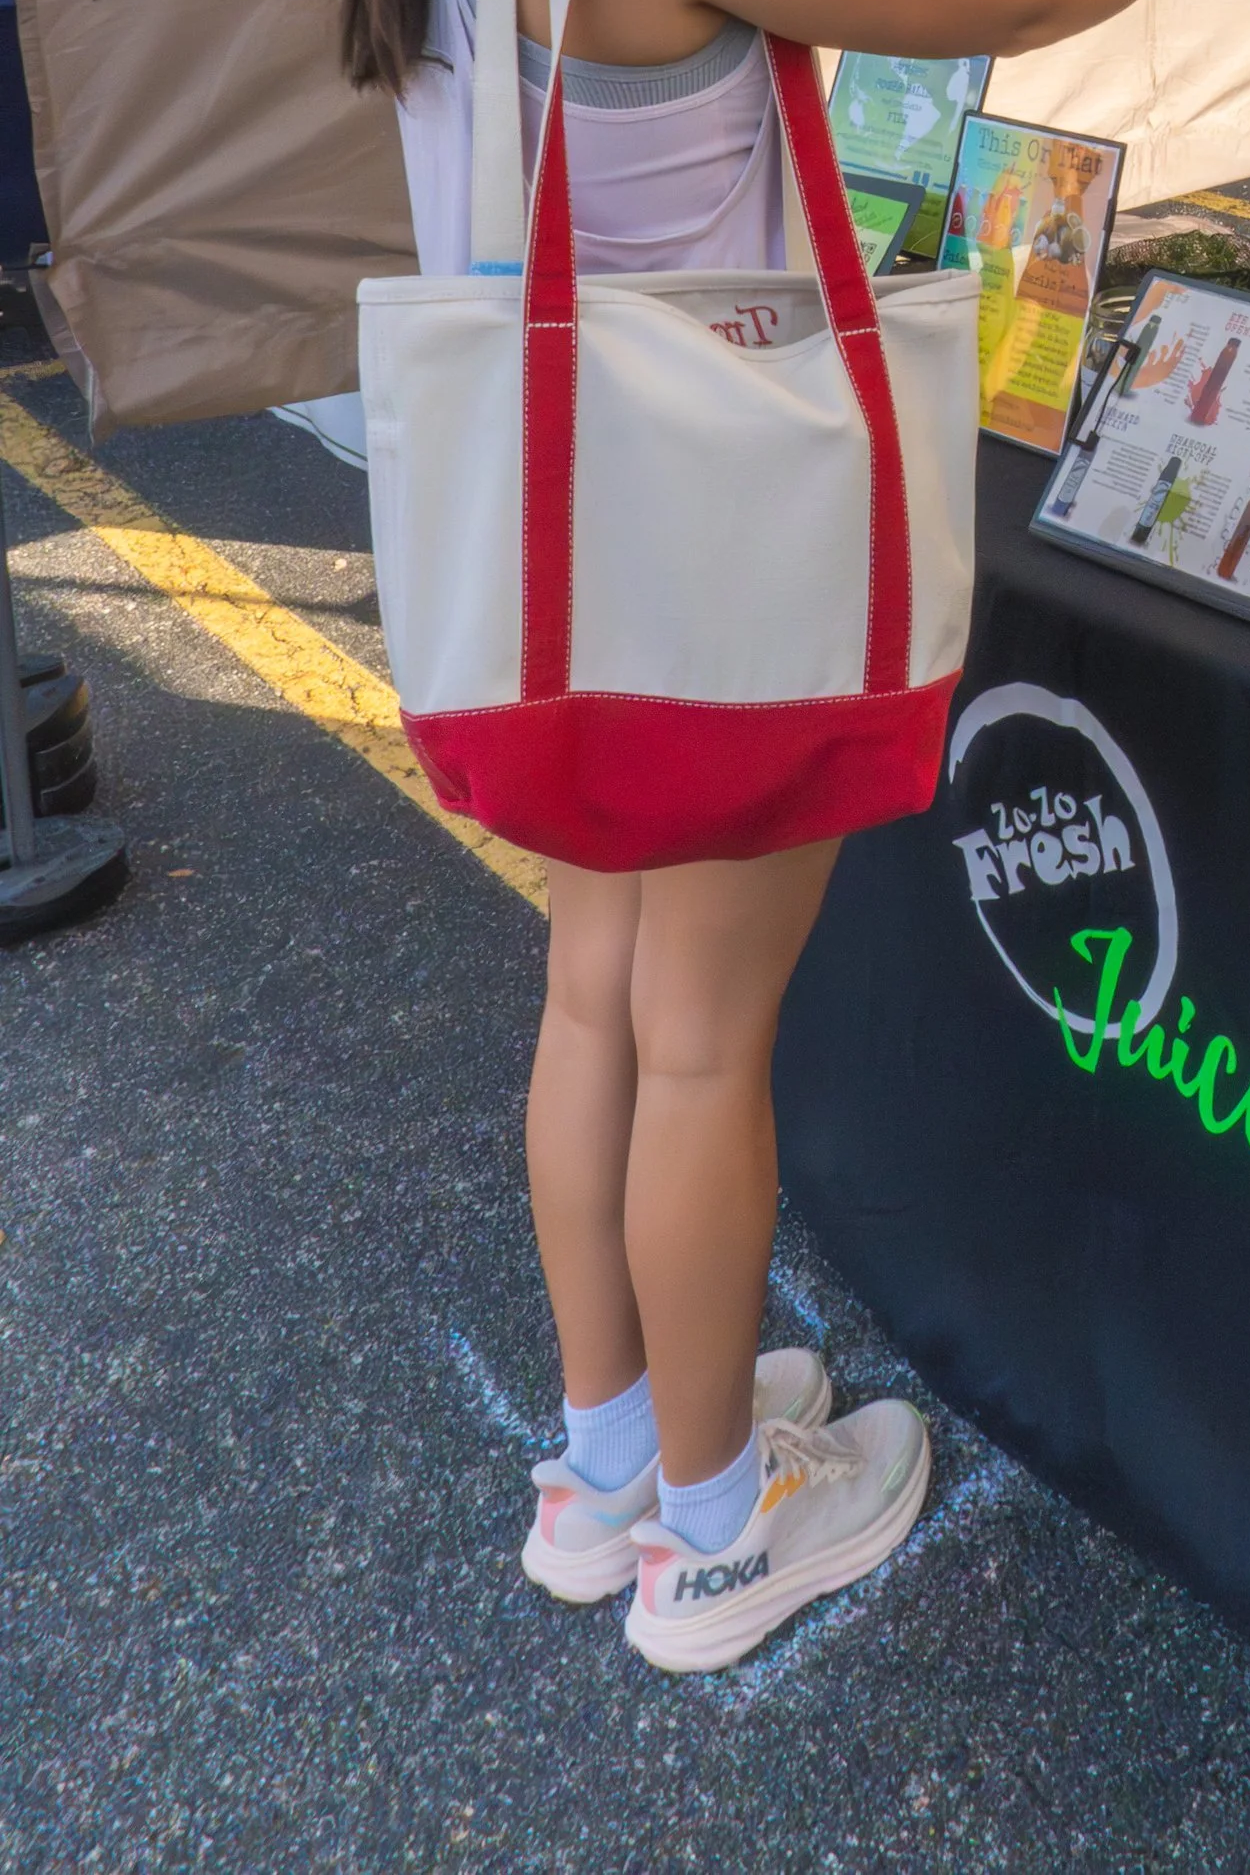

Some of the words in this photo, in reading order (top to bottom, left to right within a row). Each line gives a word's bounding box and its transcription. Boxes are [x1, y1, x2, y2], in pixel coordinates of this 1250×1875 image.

[978, 127, 1022, 157] This
[1027, 139, 1052, 163] Or
[952, 794, 1136, 902] Fresh
[673, 1550, 770, 1602] HOKA
